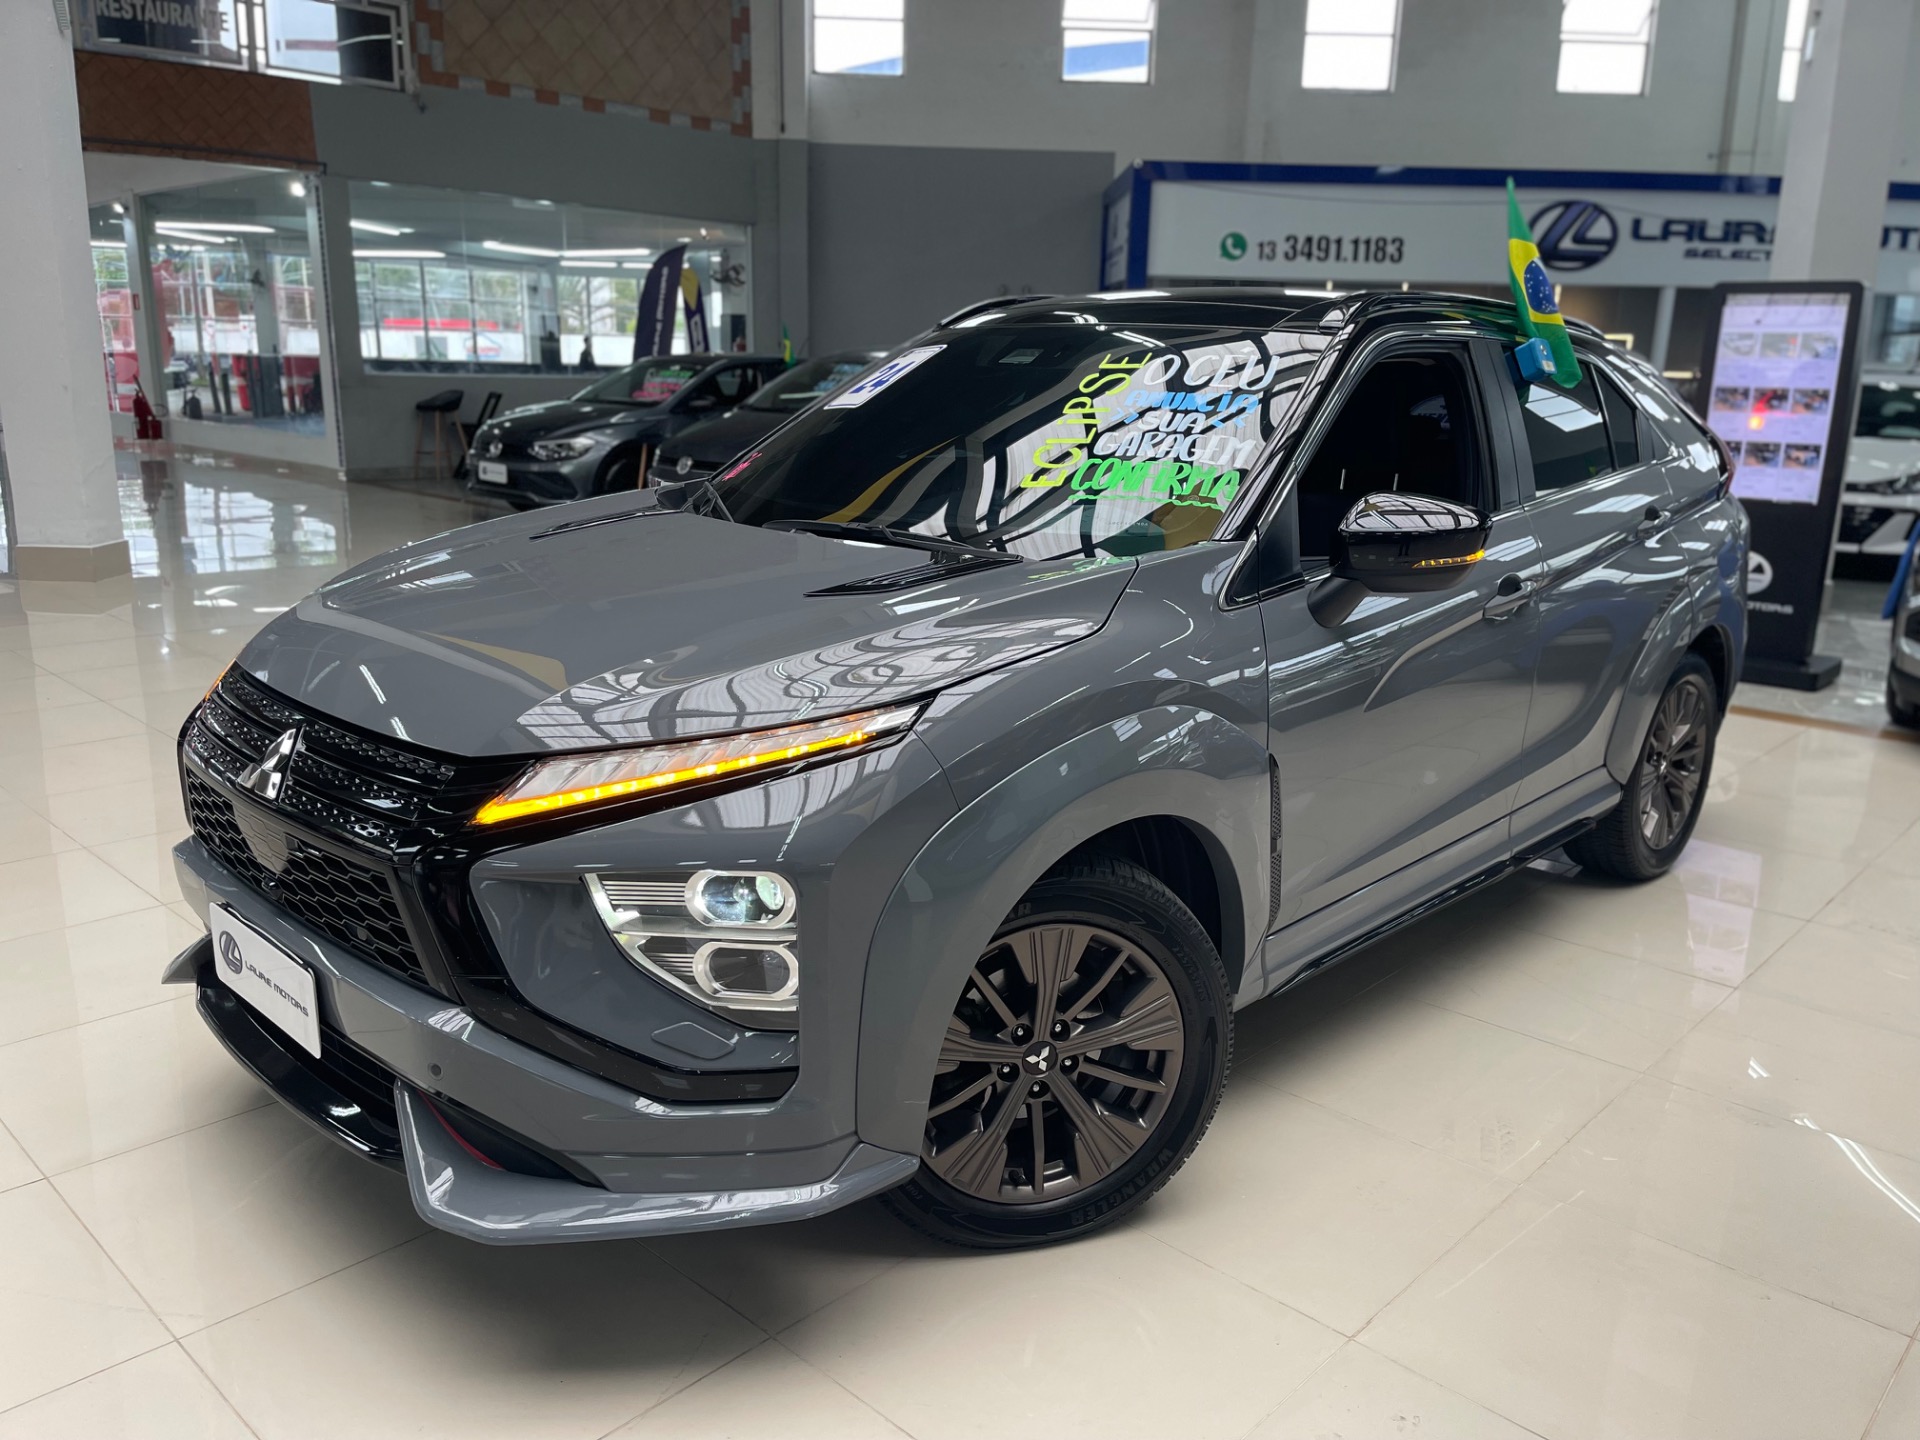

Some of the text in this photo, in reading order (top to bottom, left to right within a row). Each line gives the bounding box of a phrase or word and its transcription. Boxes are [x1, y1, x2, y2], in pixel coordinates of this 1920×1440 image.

[1631, 217, 1776, 244] LAUR
[1257, 234, 1405, 264] 13 3491.1183
[848, 360, 916, 396] 24
[1143, 354, 1182, 386] O
[1137, 409, 1207, 433] SUA
[1092, 431, 1258, 468] GARAGEM
[274, 983, 309, 1018] MOTORS
[1071, 1148, 1173, 1226] WRANGLER
